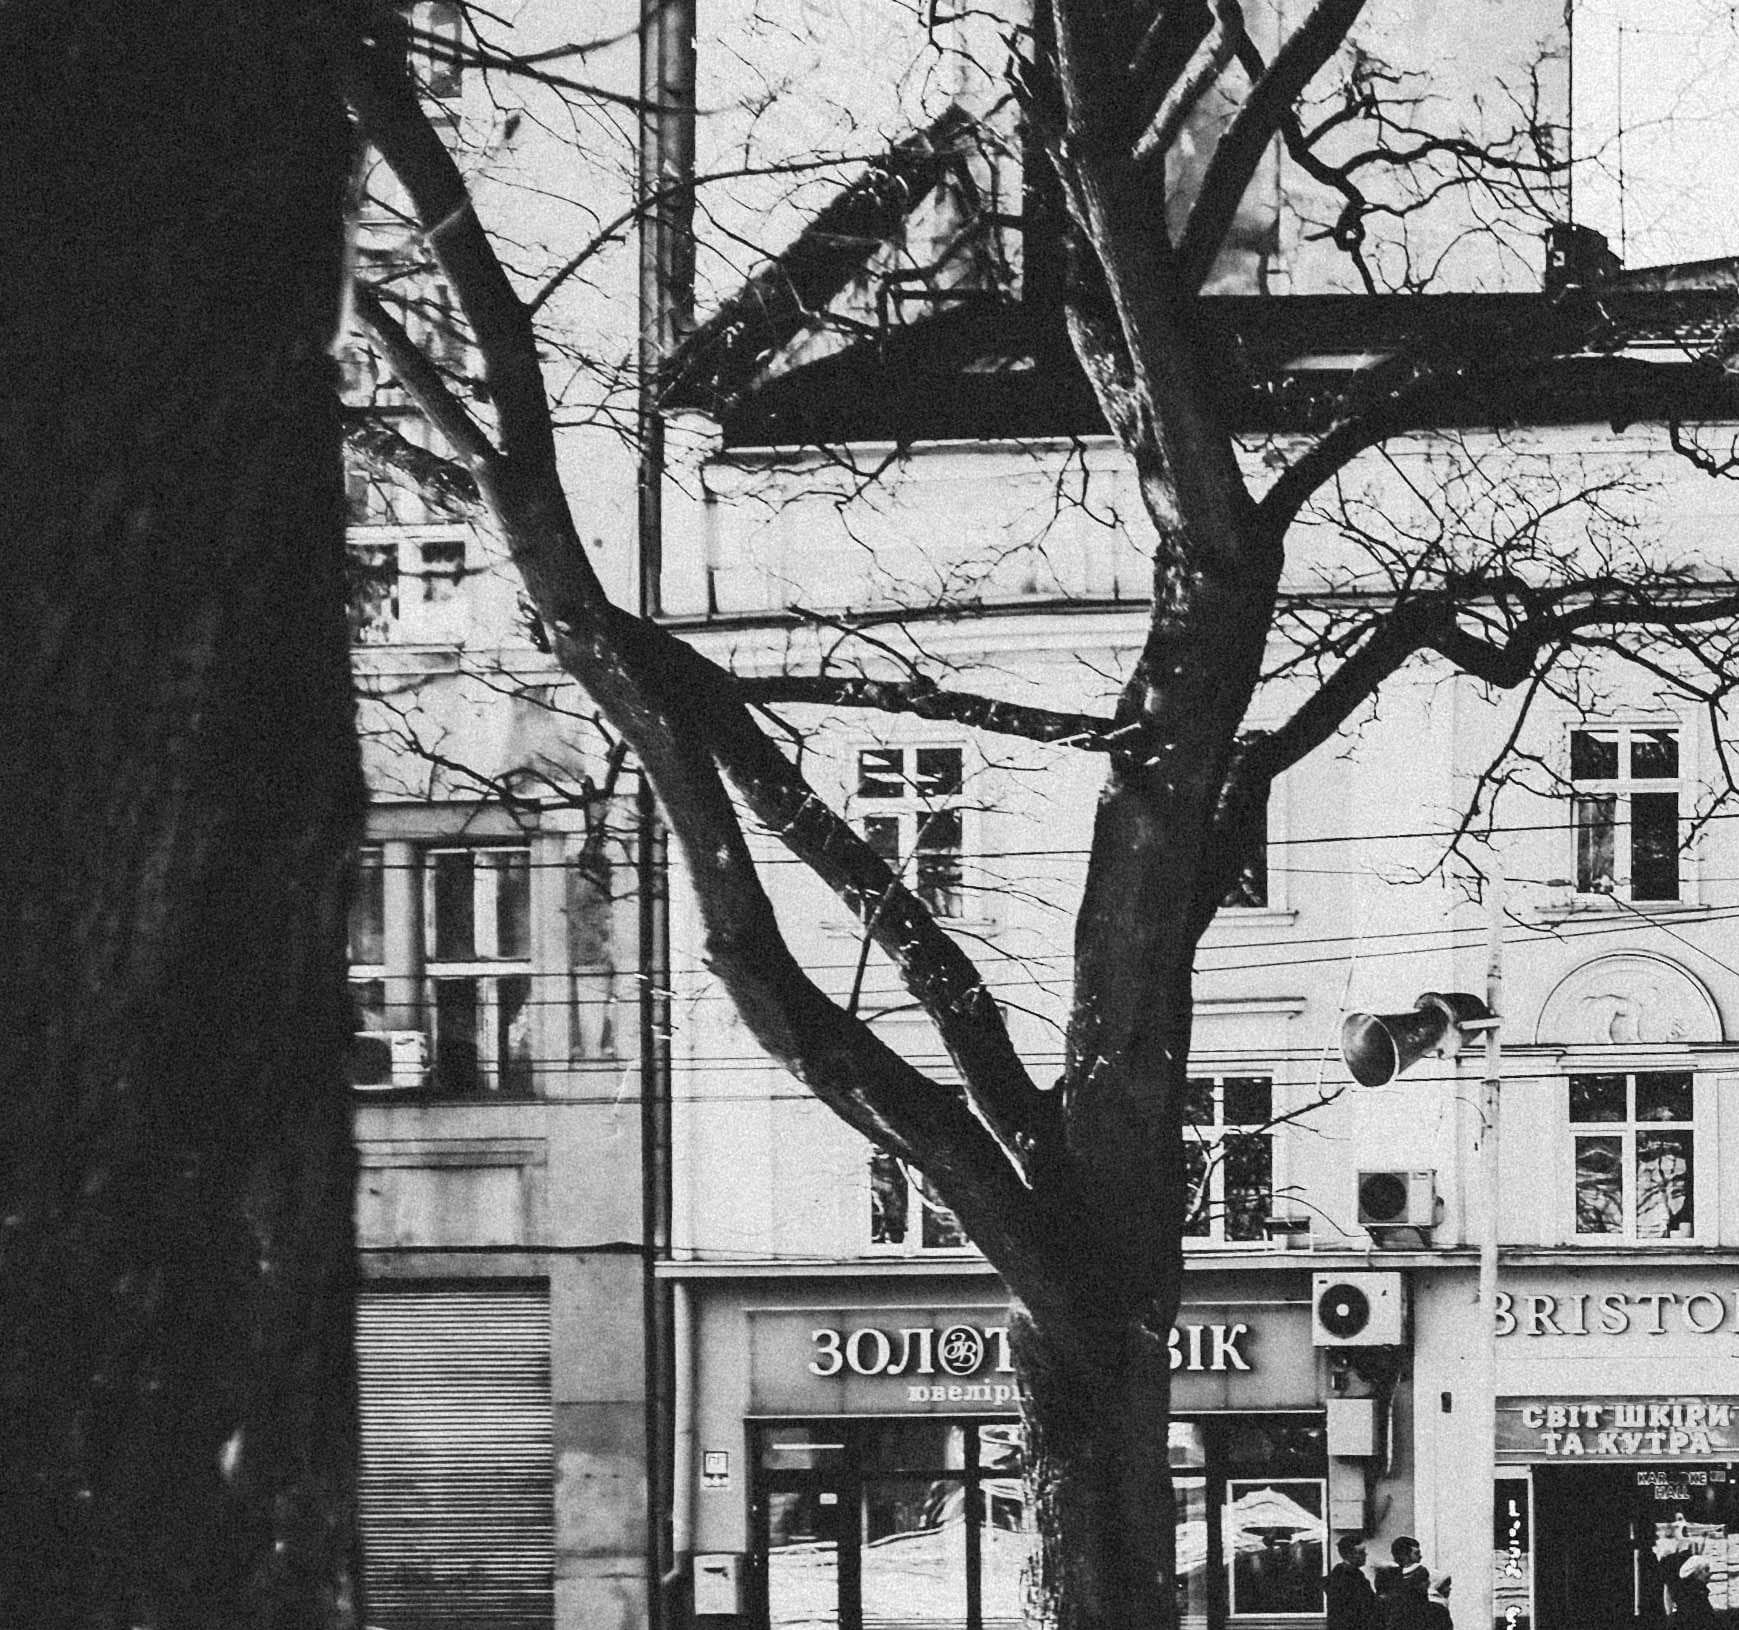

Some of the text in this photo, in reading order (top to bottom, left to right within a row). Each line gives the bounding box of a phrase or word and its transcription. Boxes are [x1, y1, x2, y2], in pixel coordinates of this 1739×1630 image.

[808, 1324, 1017, 1376] ЗОЛОТ
[1522, 1403, 1732, 1428] СВІТ ШКІРИ
[1540, 1431, 1586, 1456] ТА
[1637, 1471, 1707, 1485] KAROKE
